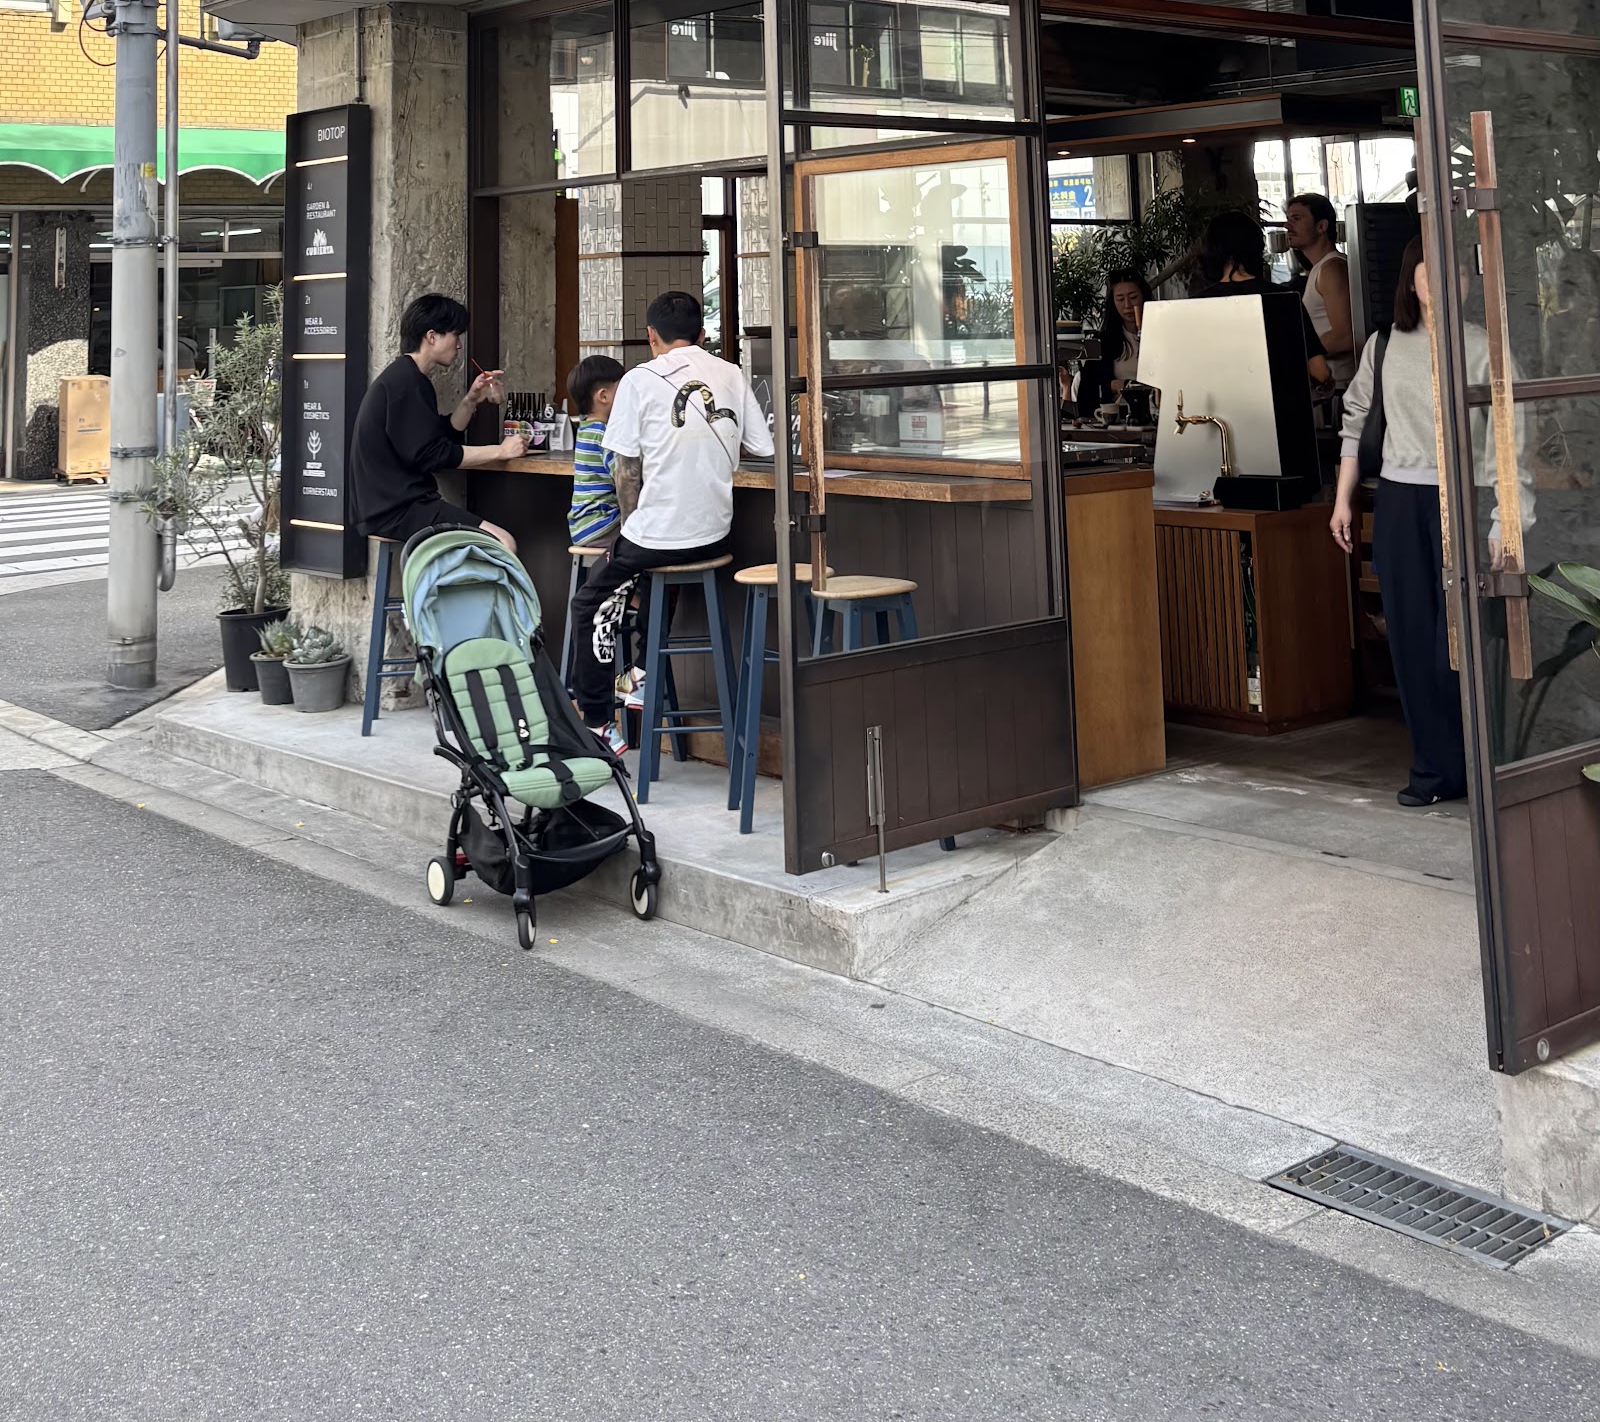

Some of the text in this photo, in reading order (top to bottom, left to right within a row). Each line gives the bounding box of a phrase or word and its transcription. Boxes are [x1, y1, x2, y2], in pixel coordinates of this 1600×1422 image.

[317, 125, 345, 141] BIOTOP
[306, 202, 325, 210] GARDEN
[306, 209, 336, 219] RESTAURANT
[305, 317, 318, 325] WEAR
[304, 326, 337, 335] ACCESSORIES
[303, 402, 317, 410] WEAR
[303, 411, 330, 419] COSMETICS
